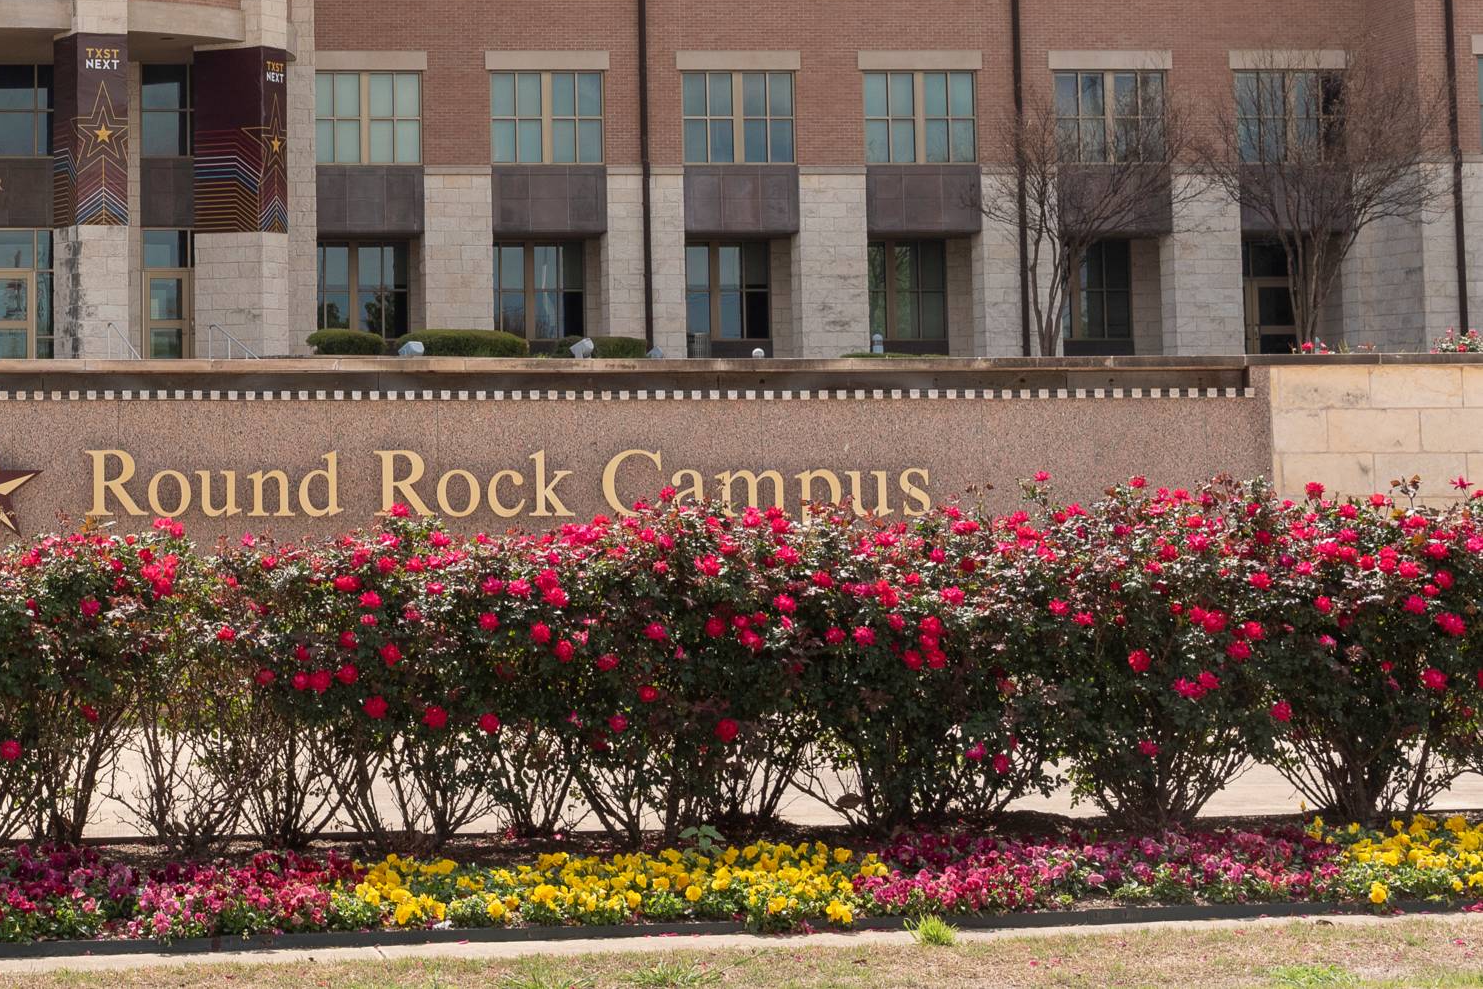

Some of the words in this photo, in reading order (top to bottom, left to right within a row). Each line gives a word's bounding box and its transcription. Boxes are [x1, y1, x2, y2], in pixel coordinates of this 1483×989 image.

[85, 47, 120, 59] TXST
[85, 58, 120, 70] NEXT
[266, 60, 284, 72] TXST
[266, 71, 285, 83] NEXT
[85, 449, 344, 518] Round
[374, 449, 576, 518] Rock
[602, 448, 932, 527] Campus
